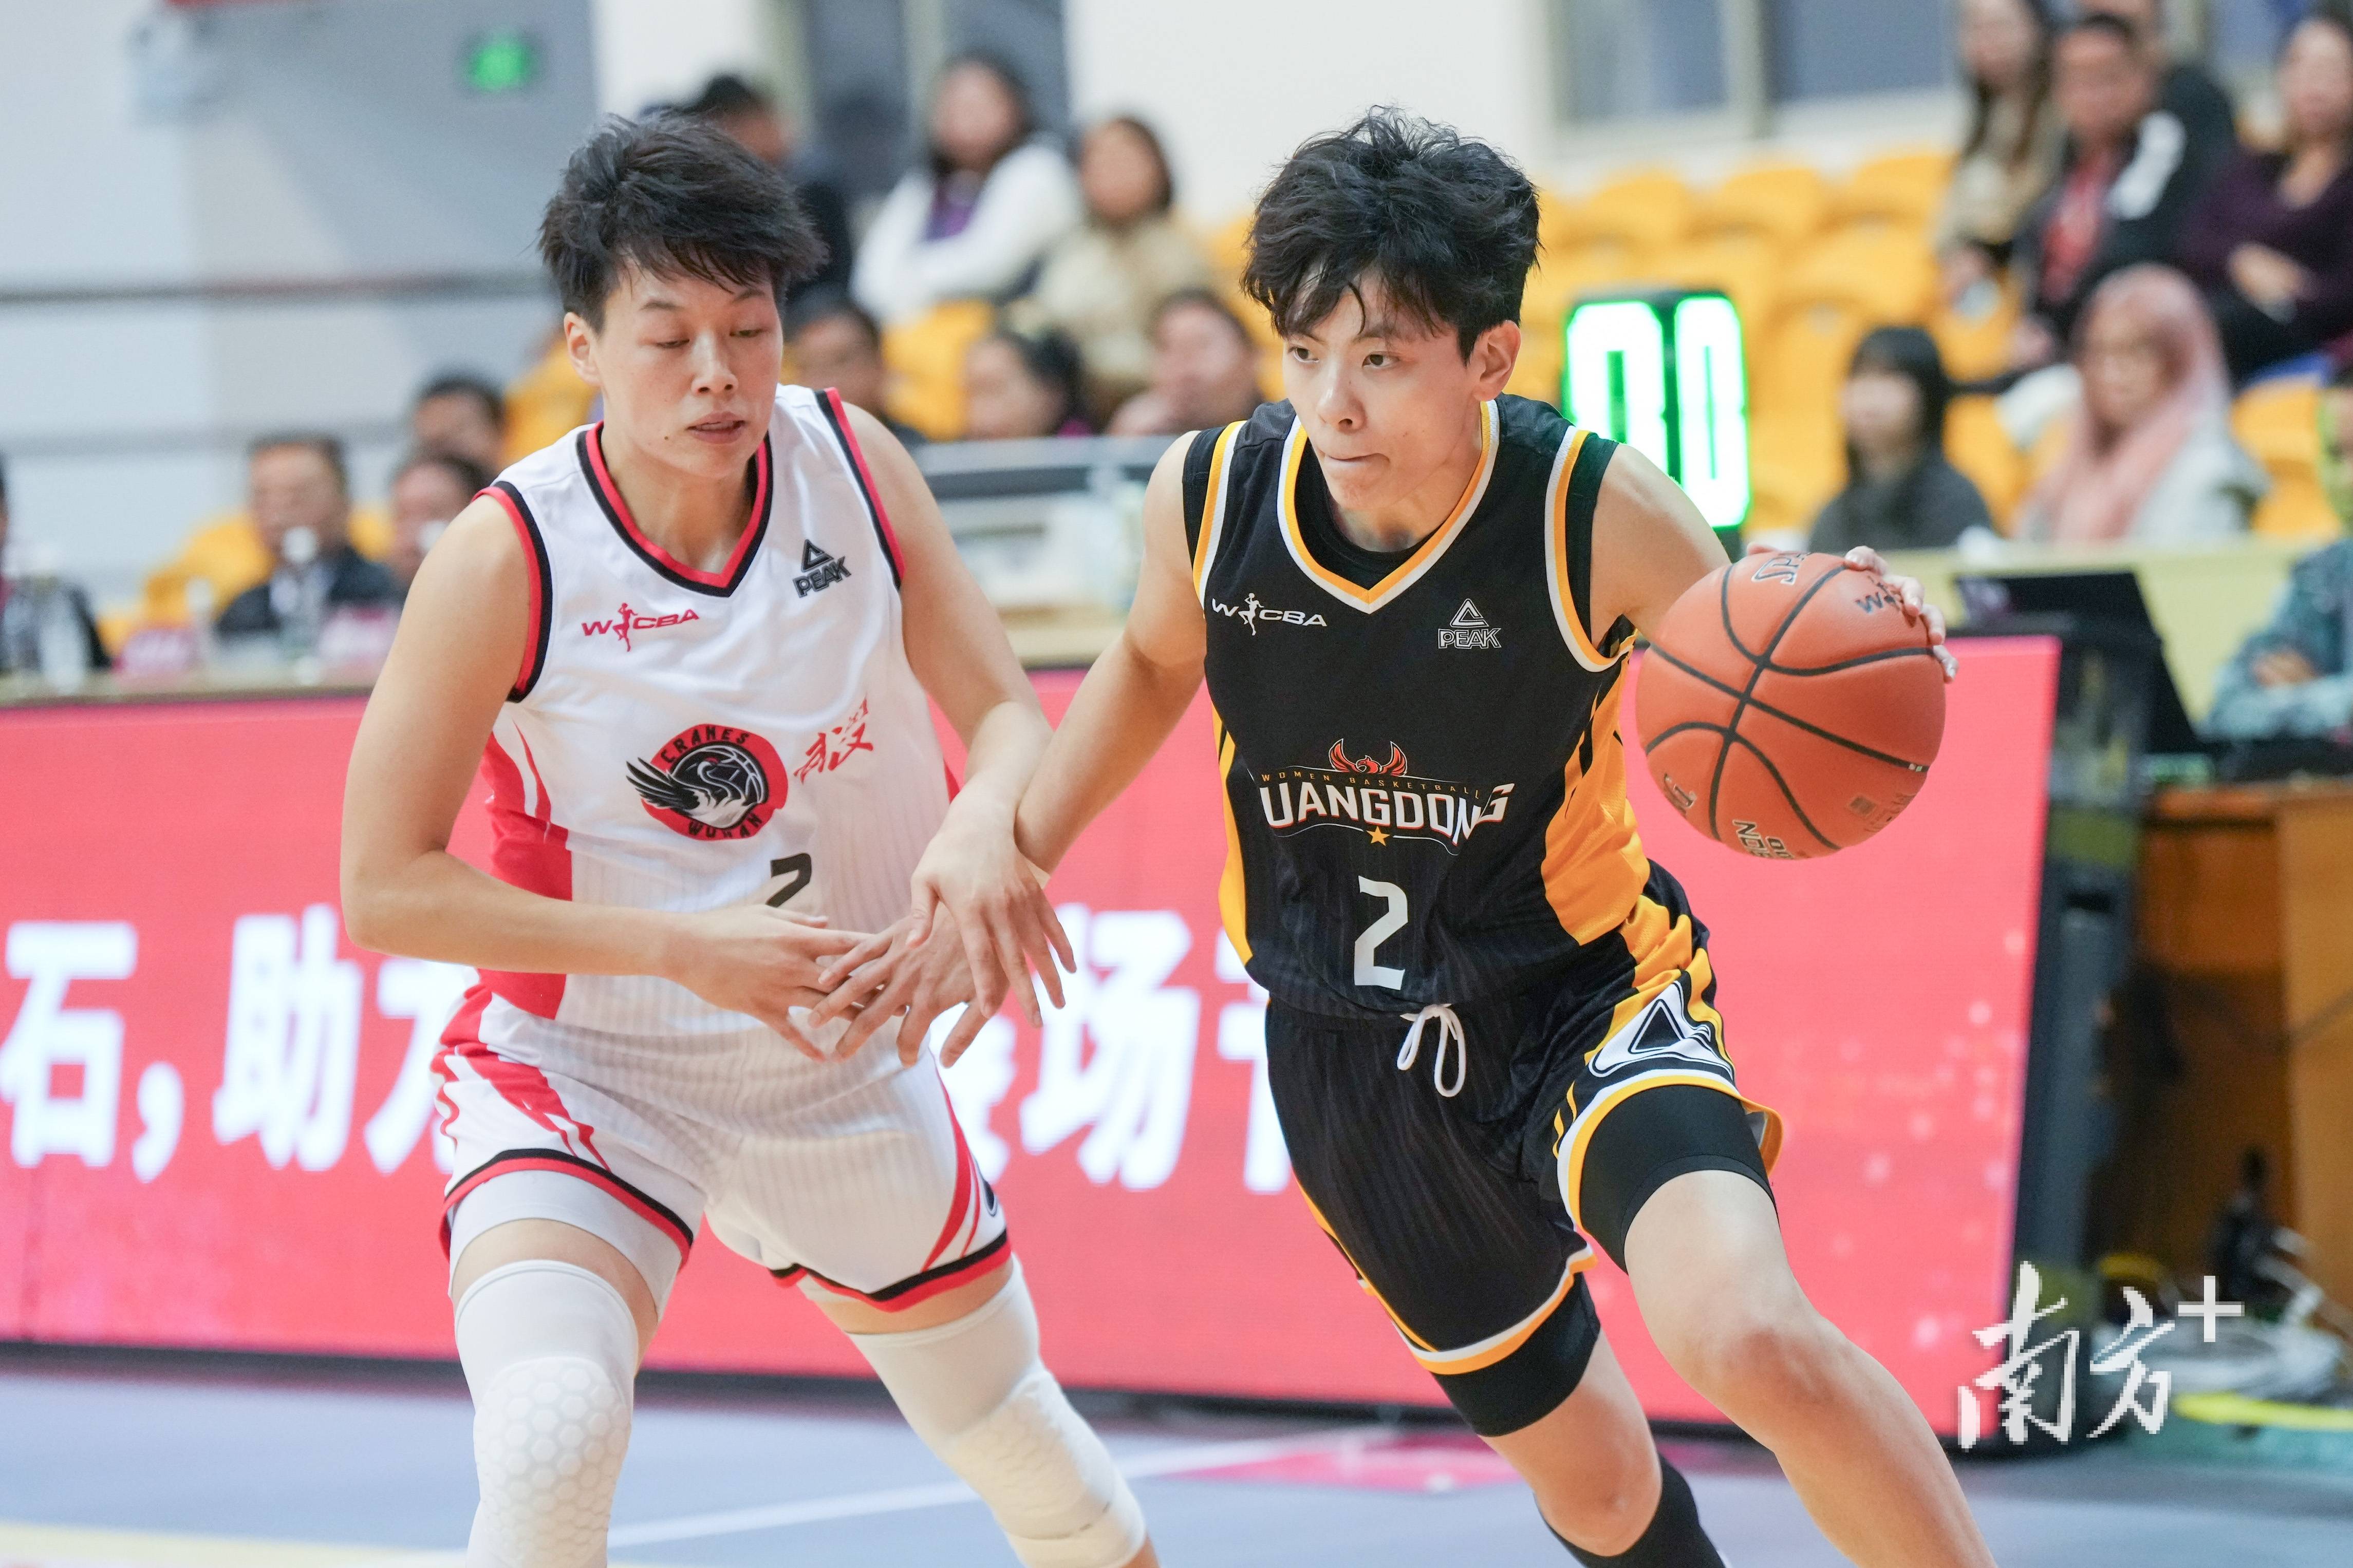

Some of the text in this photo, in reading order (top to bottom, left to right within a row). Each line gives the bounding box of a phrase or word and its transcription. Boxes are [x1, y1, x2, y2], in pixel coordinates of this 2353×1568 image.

[792, 556, 851, 598] PEAK
[1438, 628, 1502, 650] PEAK
[660, 726, 750, 764] CRANES
[1261, 770, 1480, 800] WOMEN BASKETBALL
[1259, 781, 1515, 846] UANGDONG
[1353, 875, 1409, 991] 2
